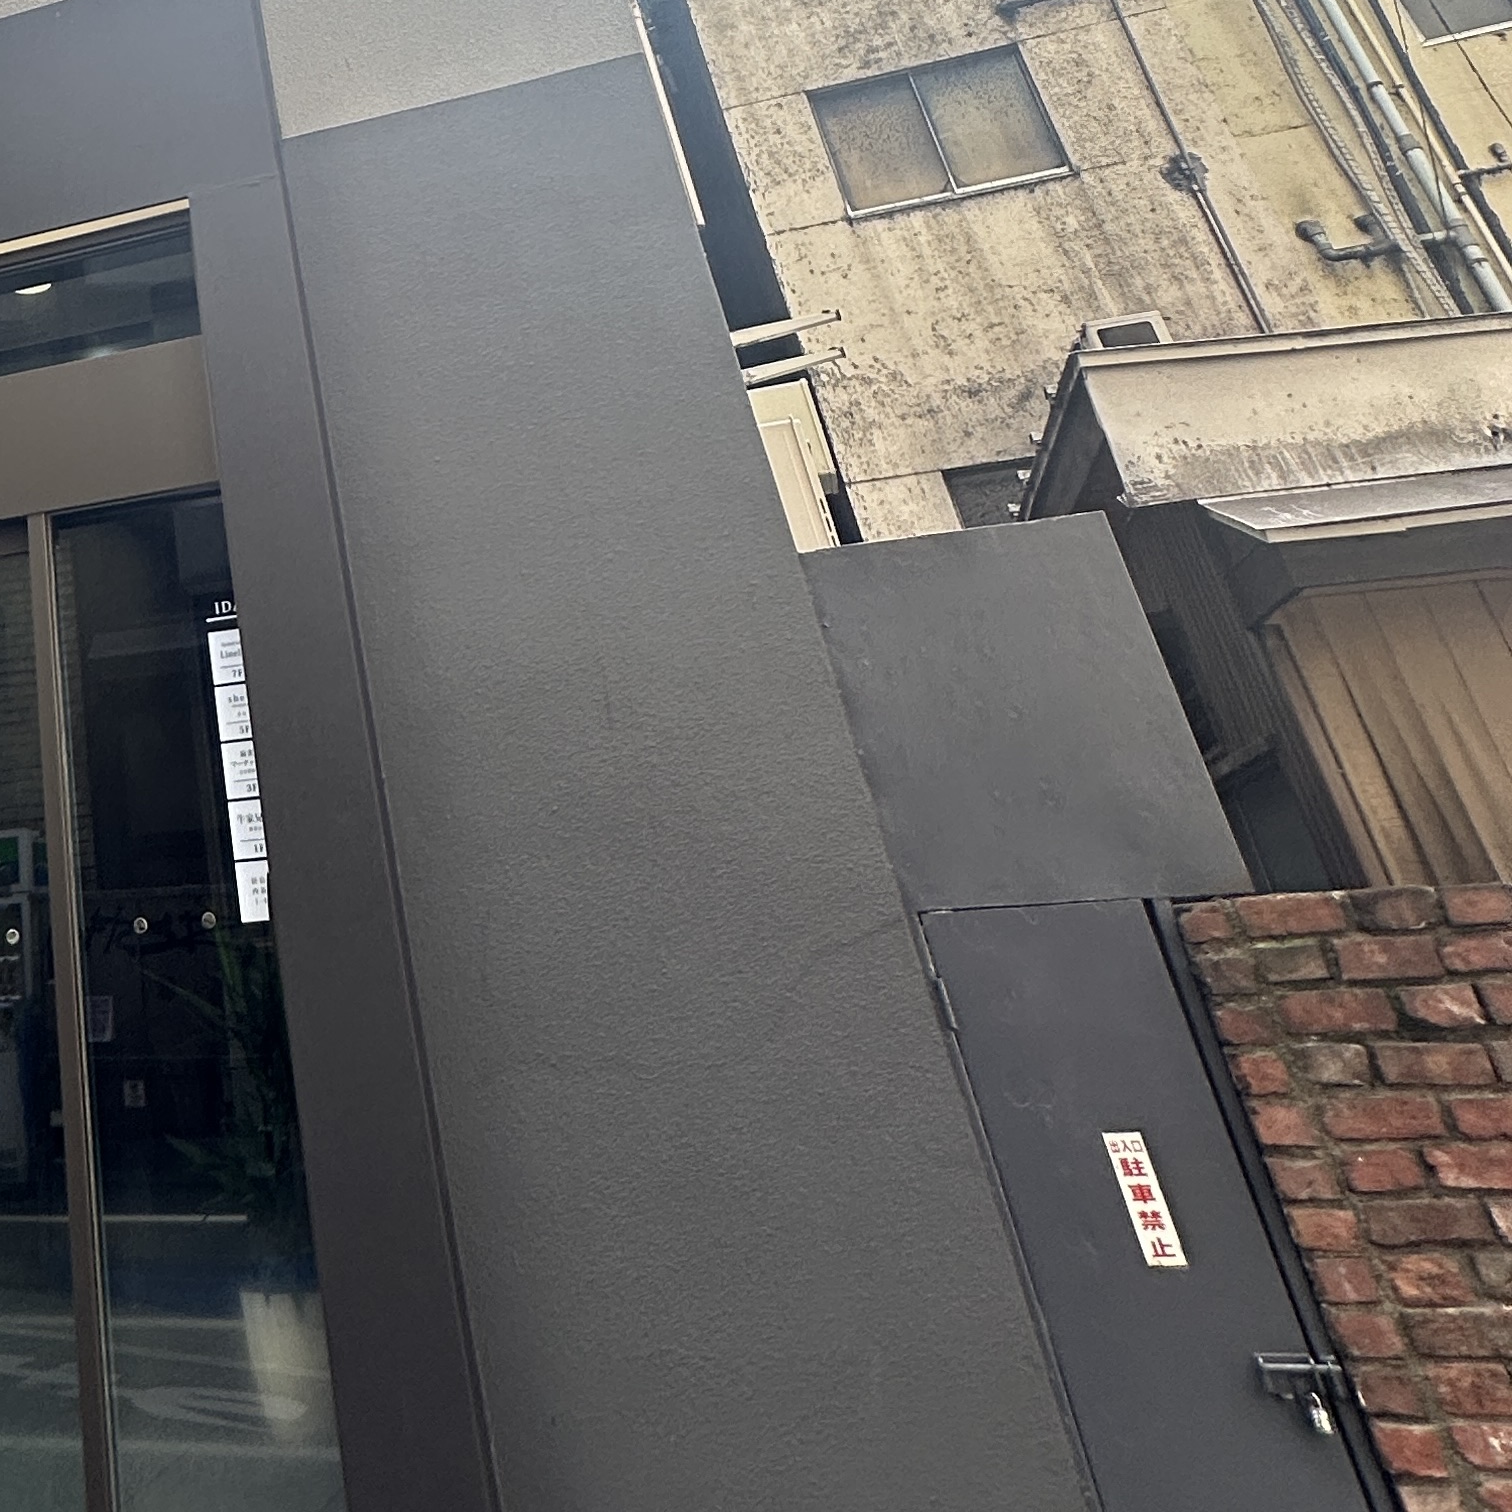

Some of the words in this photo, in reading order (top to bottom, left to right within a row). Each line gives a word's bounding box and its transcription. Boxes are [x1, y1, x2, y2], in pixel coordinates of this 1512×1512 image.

[1108, 1139, 1146, 1154] 出入口
[1118, 1157, 1177, 1258] 駐車禁止
